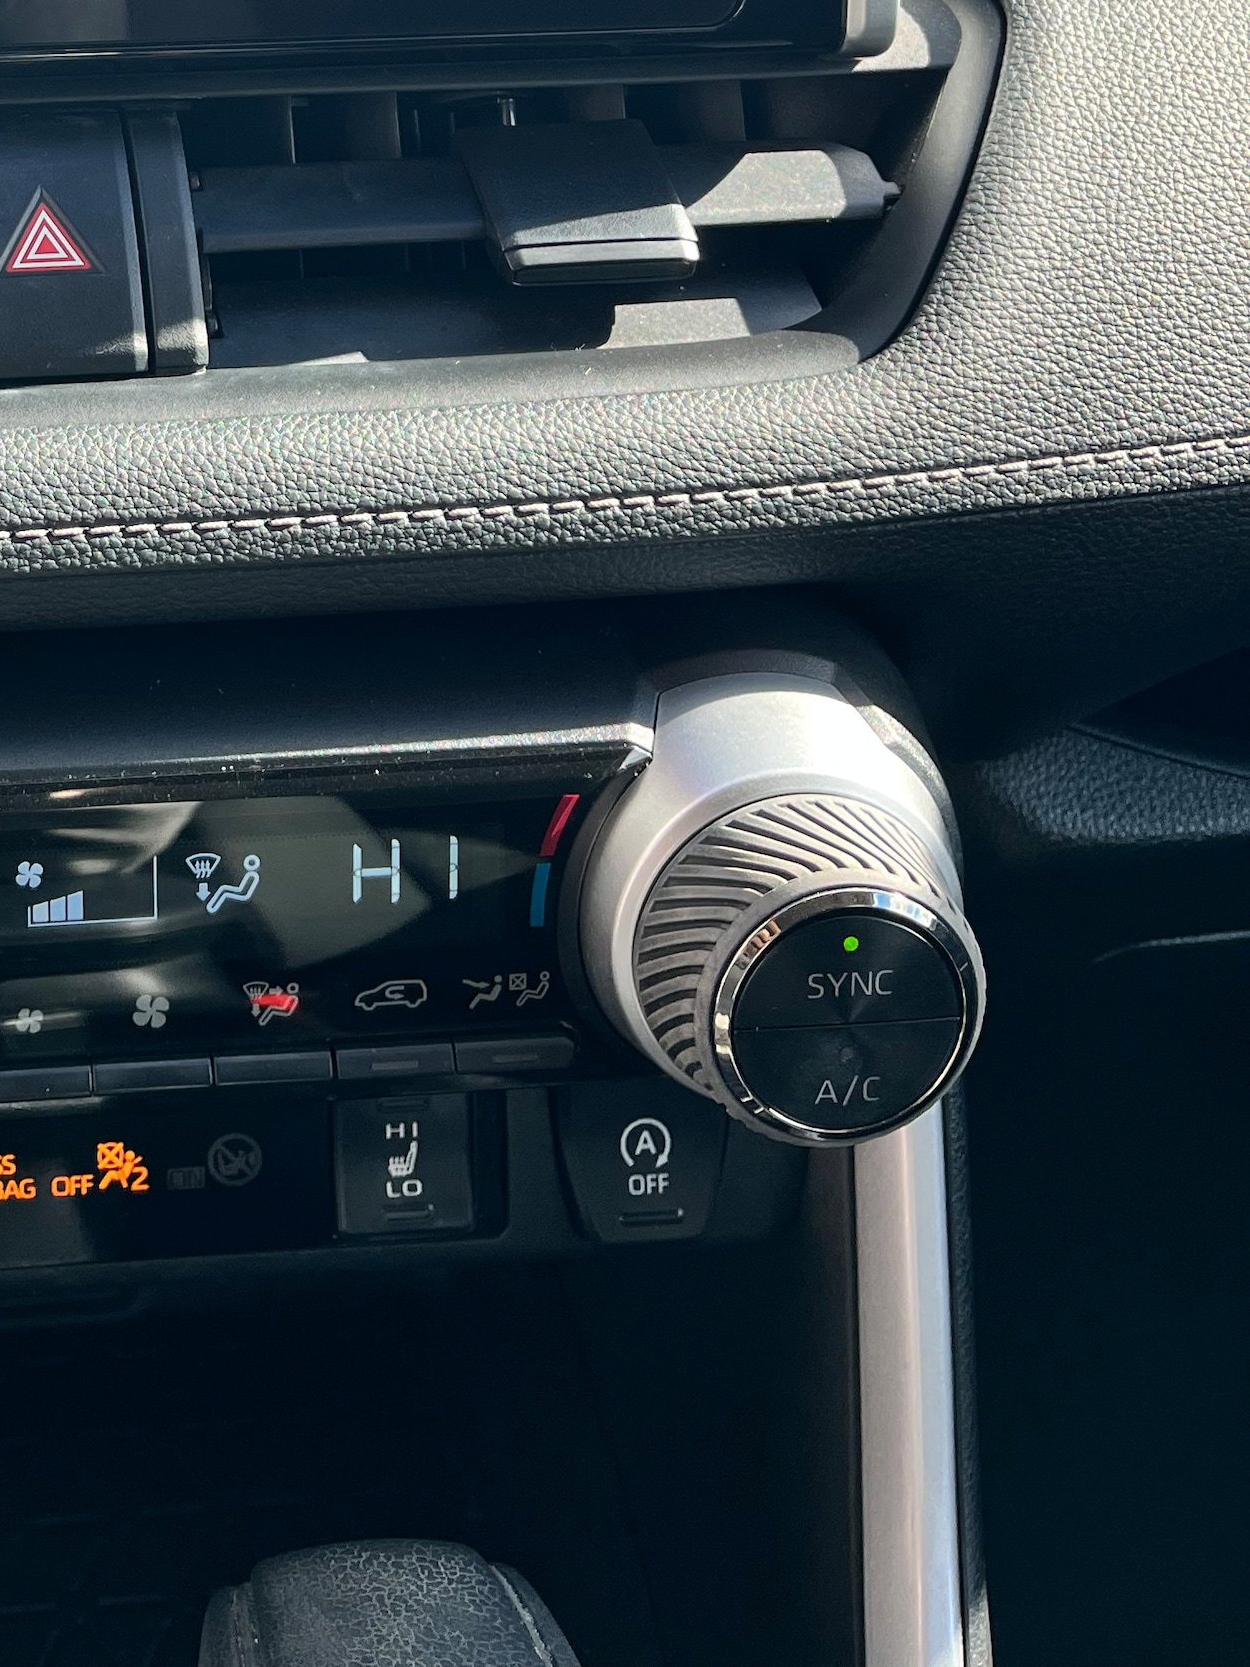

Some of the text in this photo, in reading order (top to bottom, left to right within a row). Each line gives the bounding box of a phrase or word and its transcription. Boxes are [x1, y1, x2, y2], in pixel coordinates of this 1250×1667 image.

[352, 835, 459, 904] HI
[807, 969, 894, 999] SYNC
[814, 1074, 880, 1107] A/C
[385, 1121, 419, 1140] HI
[51, 1174, 94, 1197] OFF
[385, 1179, 423, 1199] LO
[628, 1172, 670, 1196] OFF
